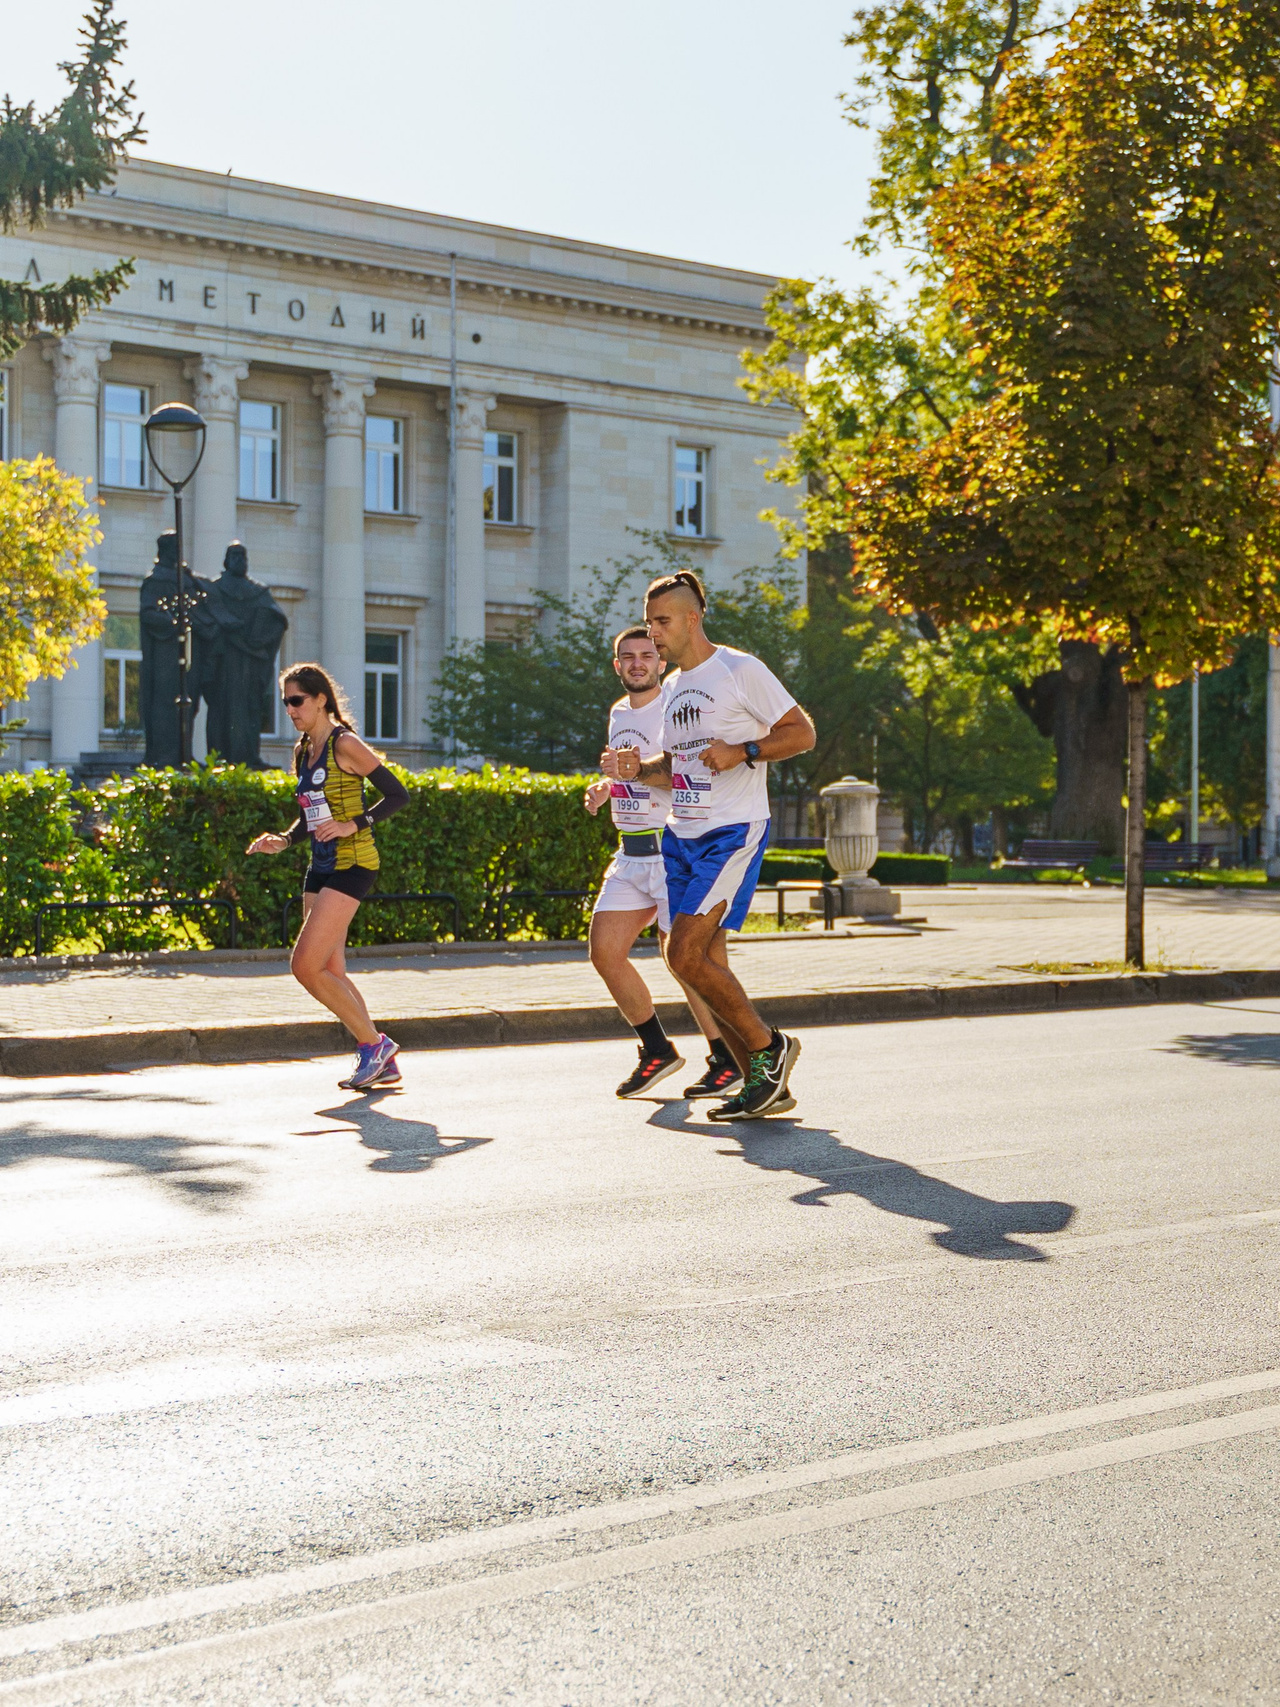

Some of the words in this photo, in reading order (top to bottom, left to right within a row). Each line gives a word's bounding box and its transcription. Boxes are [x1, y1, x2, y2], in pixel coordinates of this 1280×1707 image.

[158, 278, 427, 341] МЕТОДИЙ
[675, 790, 700, 804] 2363
[617, 799, 640, 811] 1990
